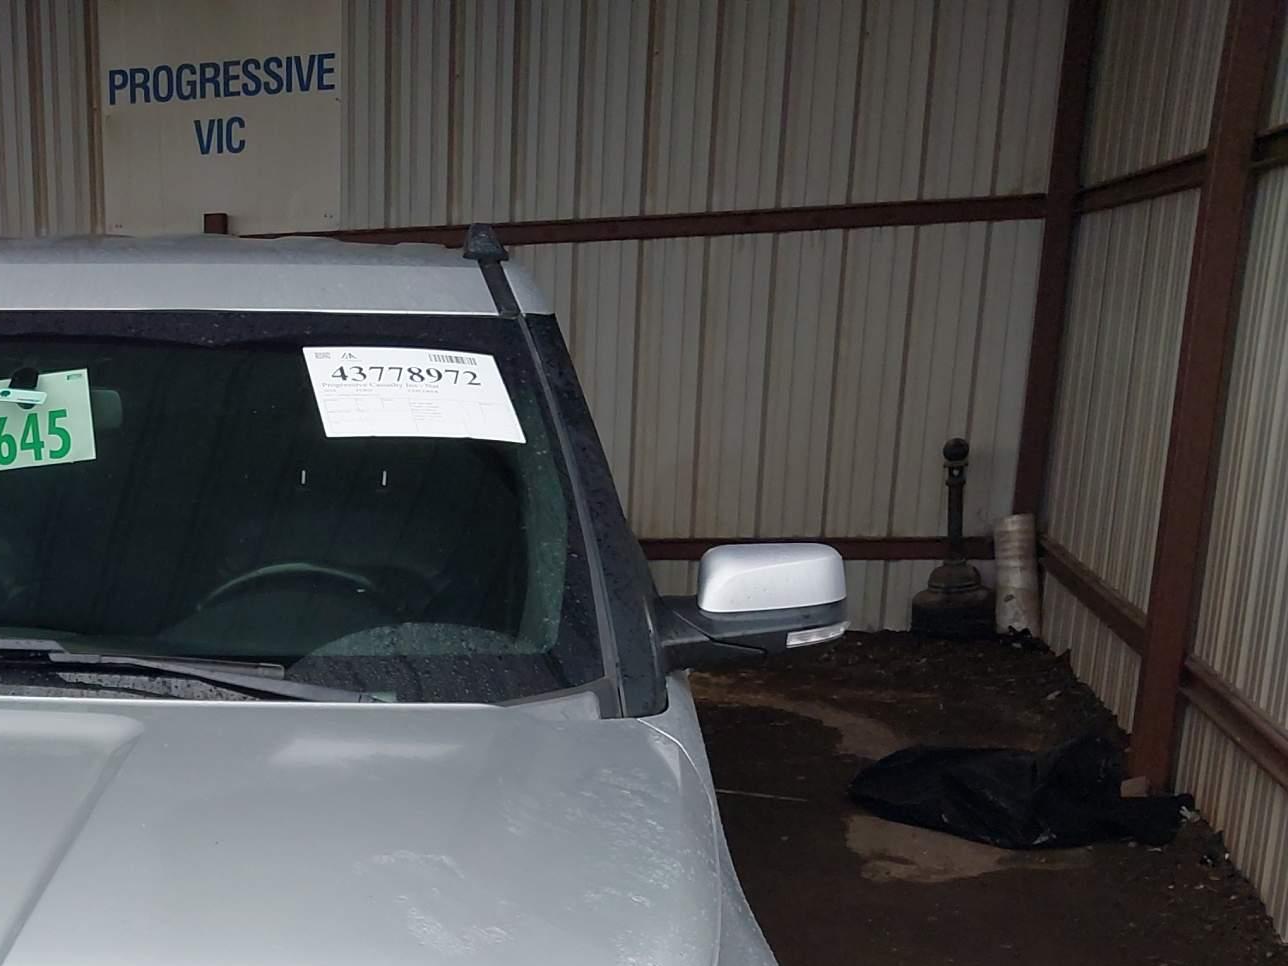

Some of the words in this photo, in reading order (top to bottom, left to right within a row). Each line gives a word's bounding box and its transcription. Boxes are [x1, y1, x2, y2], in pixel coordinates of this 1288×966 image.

[109, 53, 336, 106] PROGRESSIVE
[193, 116, 246, 155] VIC
[331, 365, 481, 386] 43778972
